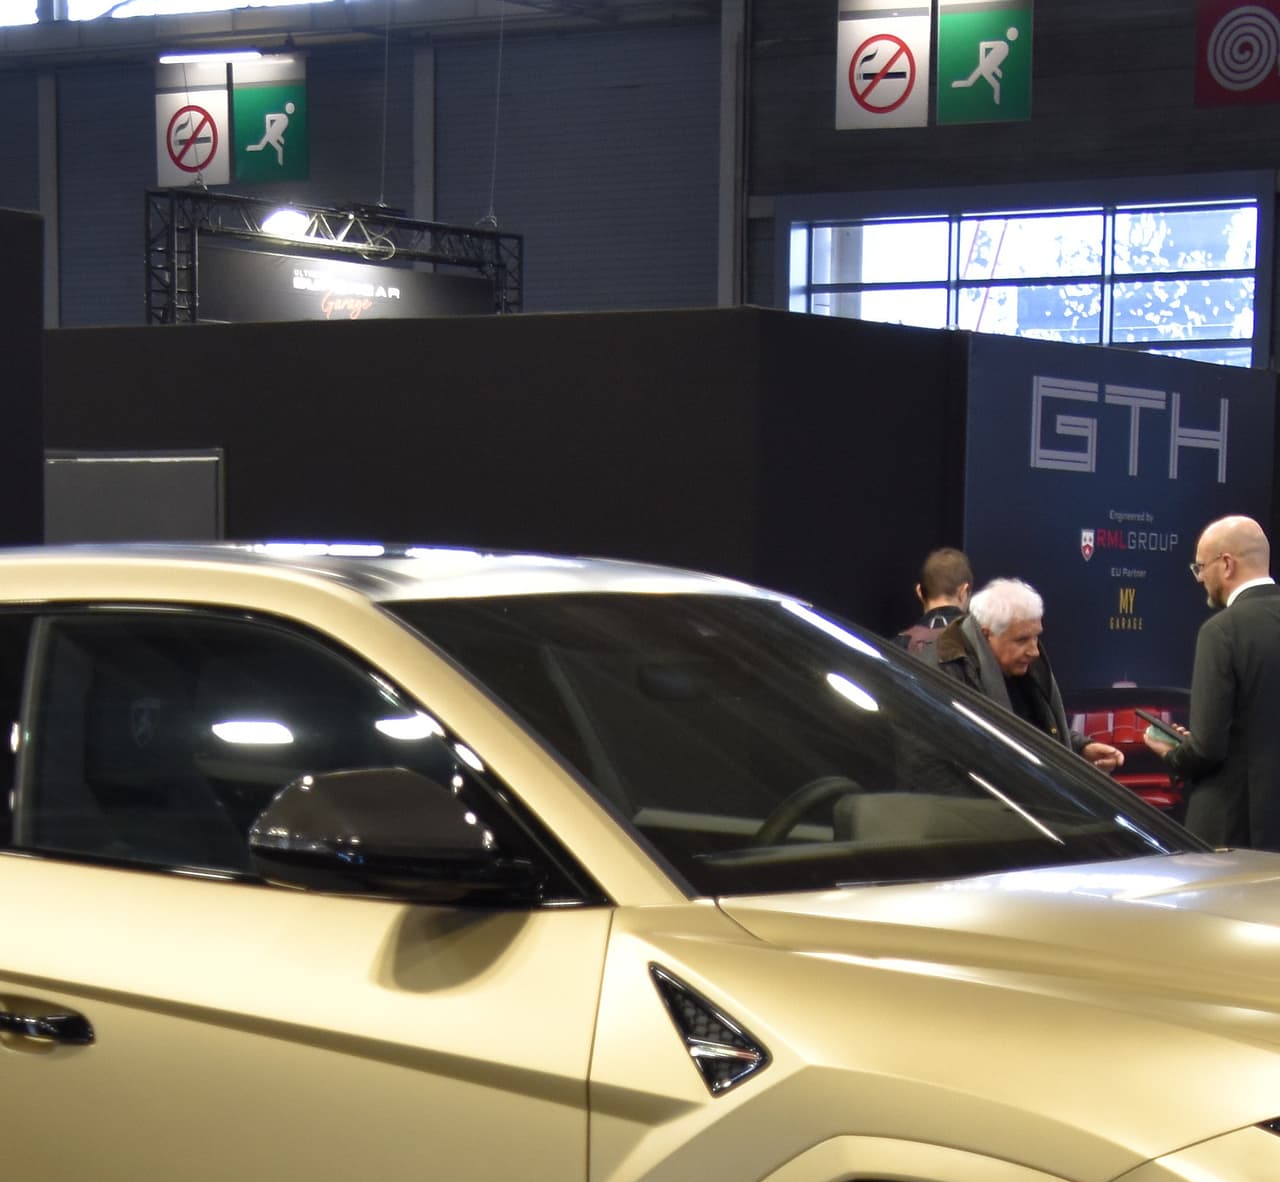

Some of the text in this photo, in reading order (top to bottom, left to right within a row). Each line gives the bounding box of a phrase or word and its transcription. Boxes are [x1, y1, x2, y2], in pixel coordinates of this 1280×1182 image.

[1030, 375, 1229, 484] GTH
[1122, 568, 1147, 578] Partner
[1120, 588, 1135, 614] MY
[1109, 617, 1143, 631] GARAGE
